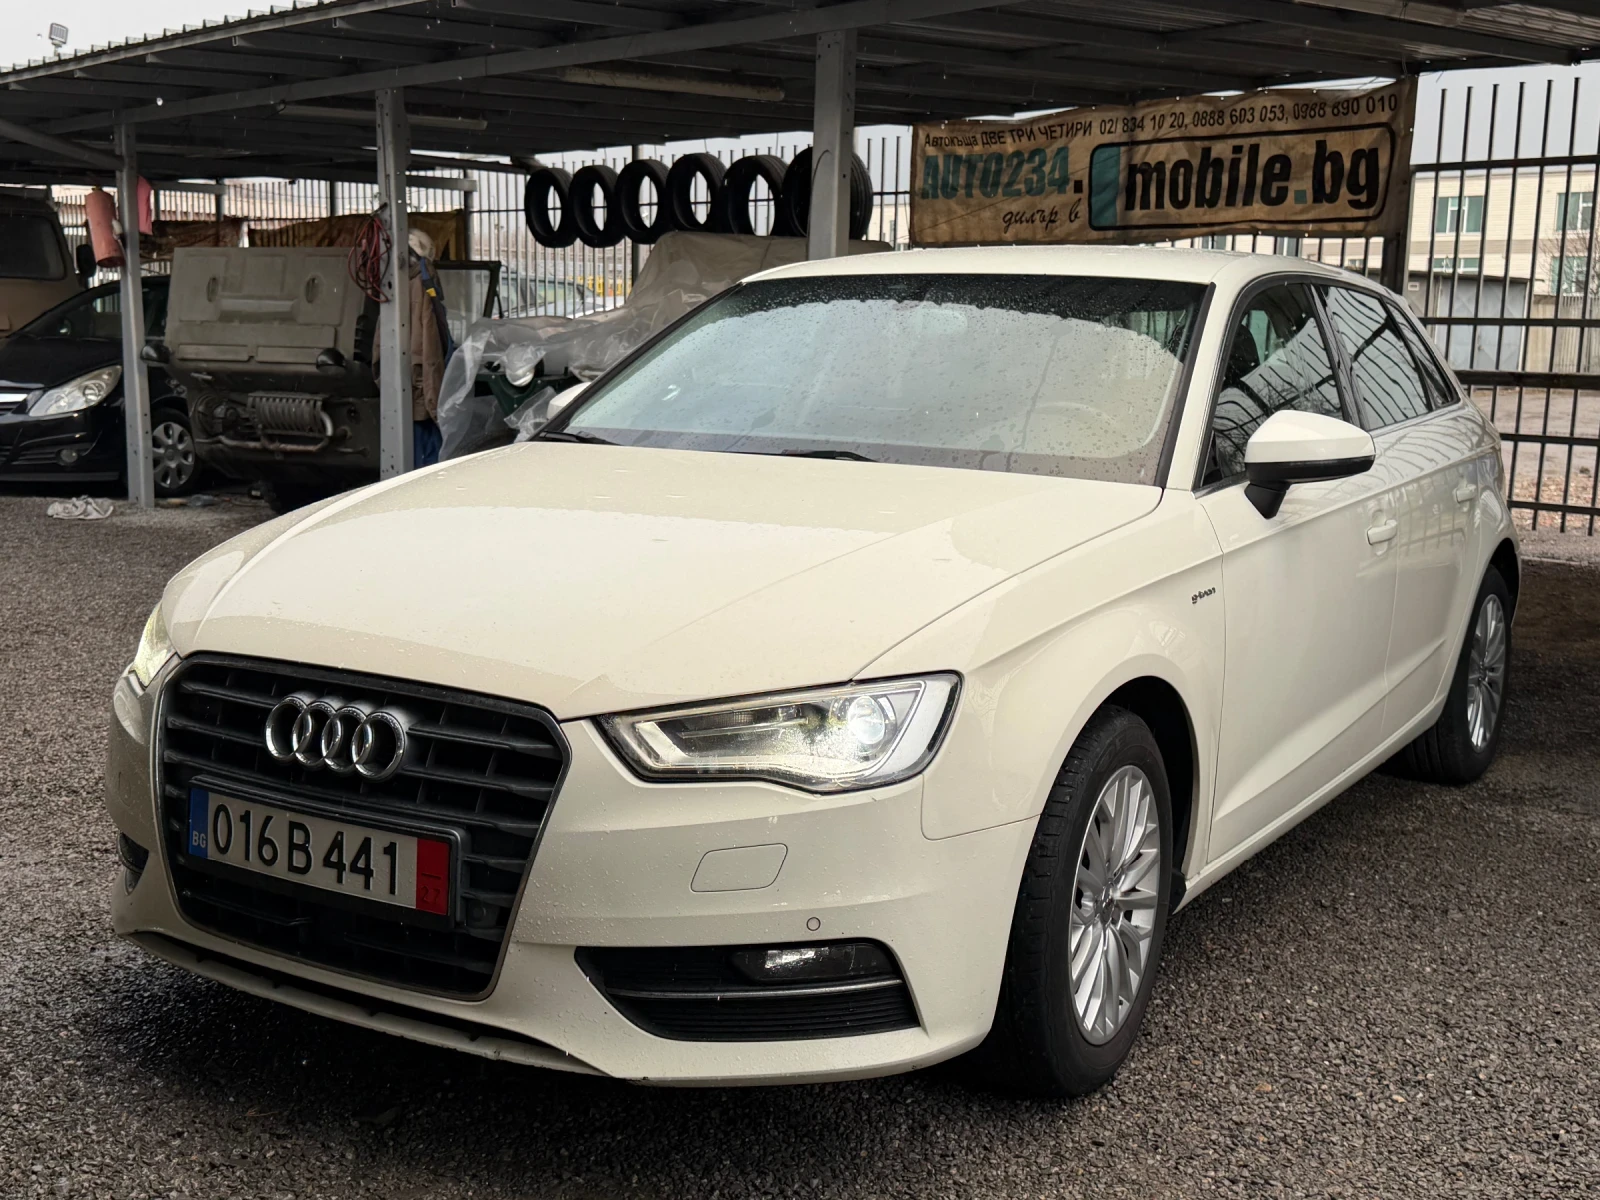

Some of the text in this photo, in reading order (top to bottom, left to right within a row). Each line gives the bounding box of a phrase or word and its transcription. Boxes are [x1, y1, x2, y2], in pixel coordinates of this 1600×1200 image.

[924, 133, 978, 149] Автокъща
[980, 131, 1006, 148] ДВЕ
[1009, 127, 1036, 144] ТРИ
[1038, 120, 1093, 140] ЧЕТИРИ
[1122, 116, 1145, 133] 834
[1151, 114, 1165, 130] 10
[1169, 112, 1188, 130] 20,
[1192, 110, 1225, 127] 0888
[1229, 107, 1255, 125] 603
[1260, 104, 1289, 124] 053,
[1366, 94, 1398, 114] 010
[1125, 140, 1380, 210] mobile.bg
[1002, 198, 1082, 234] дилър в
[192, 830, 206, 848] BG
[421, 885, 441, 904] 27
